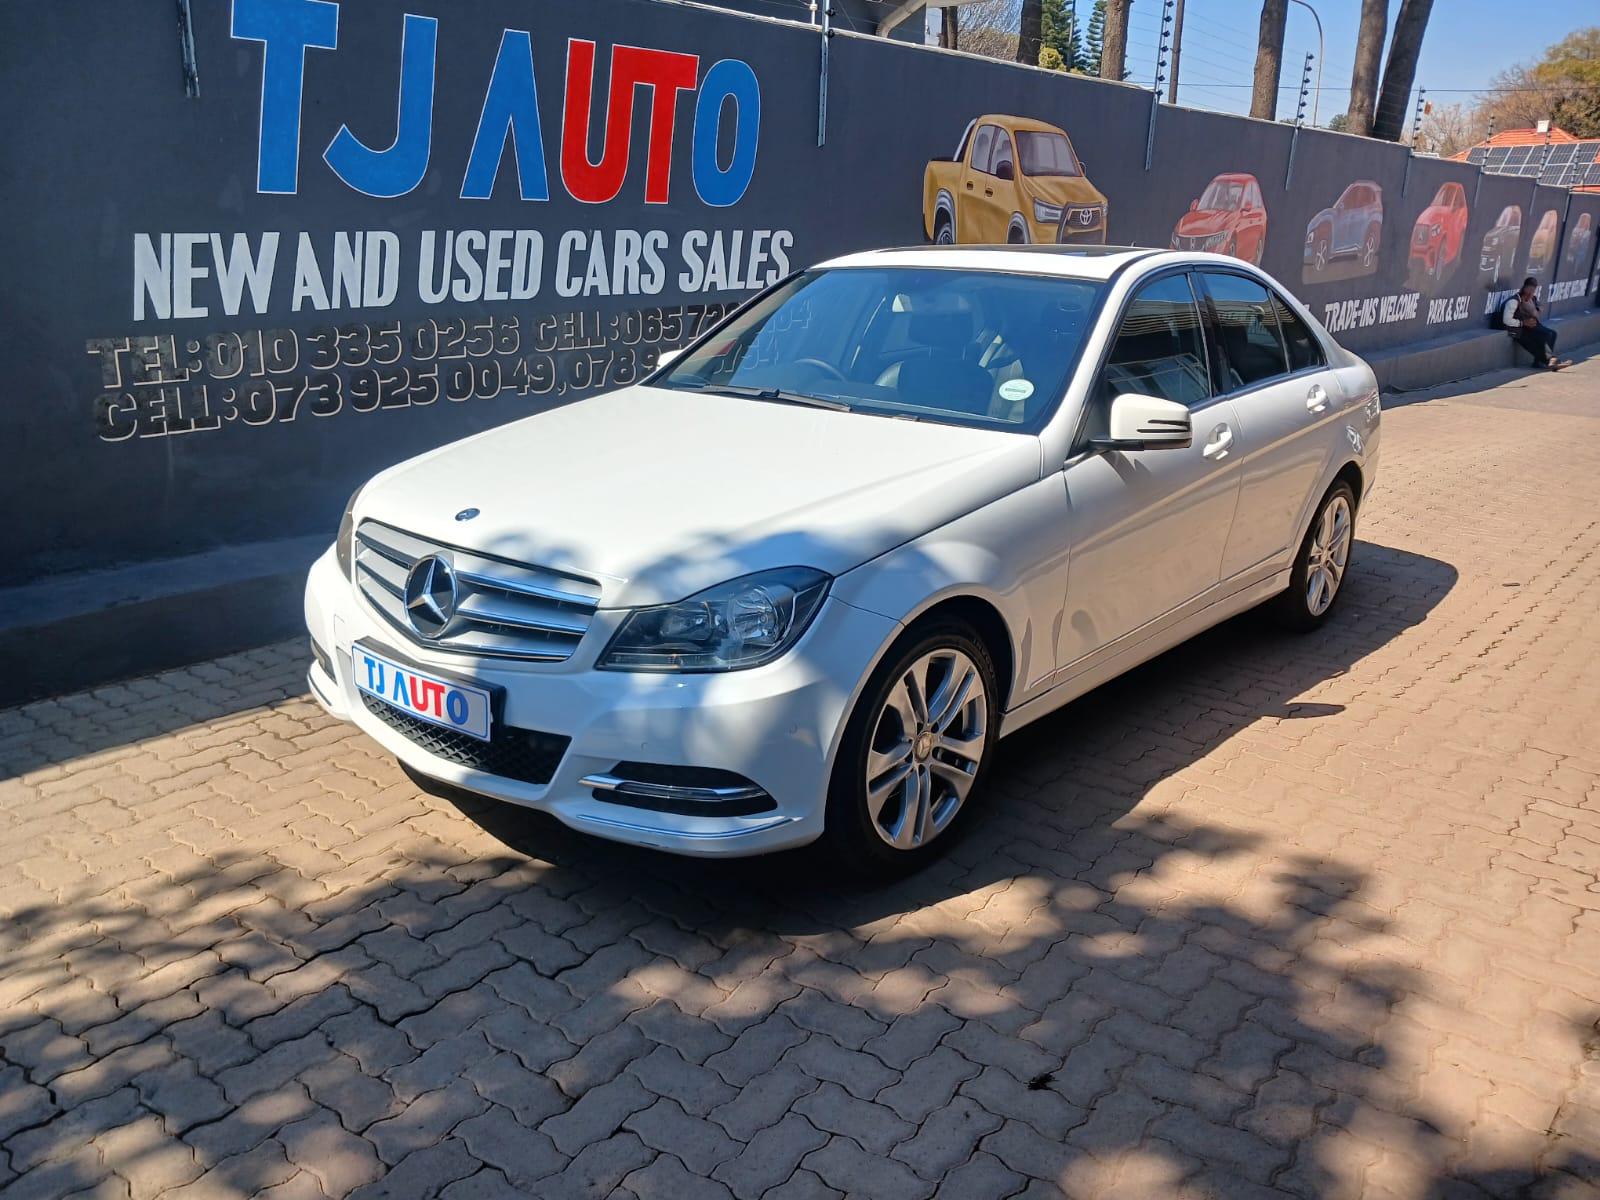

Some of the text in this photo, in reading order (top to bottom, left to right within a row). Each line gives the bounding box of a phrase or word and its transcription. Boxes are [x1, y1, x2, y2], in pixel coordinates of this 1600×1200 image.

[231, 0, 761, 208] TJ AUTO
[133, 229, 795, 321] NEW AND USED CARS SALES
[1324, 293, 1420, 334] TRADE-INS WELCOME
[1426, 298, 1448, 326] PARK
[1445, 297, 1454, 322] &
[1454, 295, 1471, 321] SELL
[306, 320, 402, 369] 335
[411, 315, 521, 361] 0256
[350, 364, 440, 413] 925
[363, 655, 470, 726] TJ AUTO
